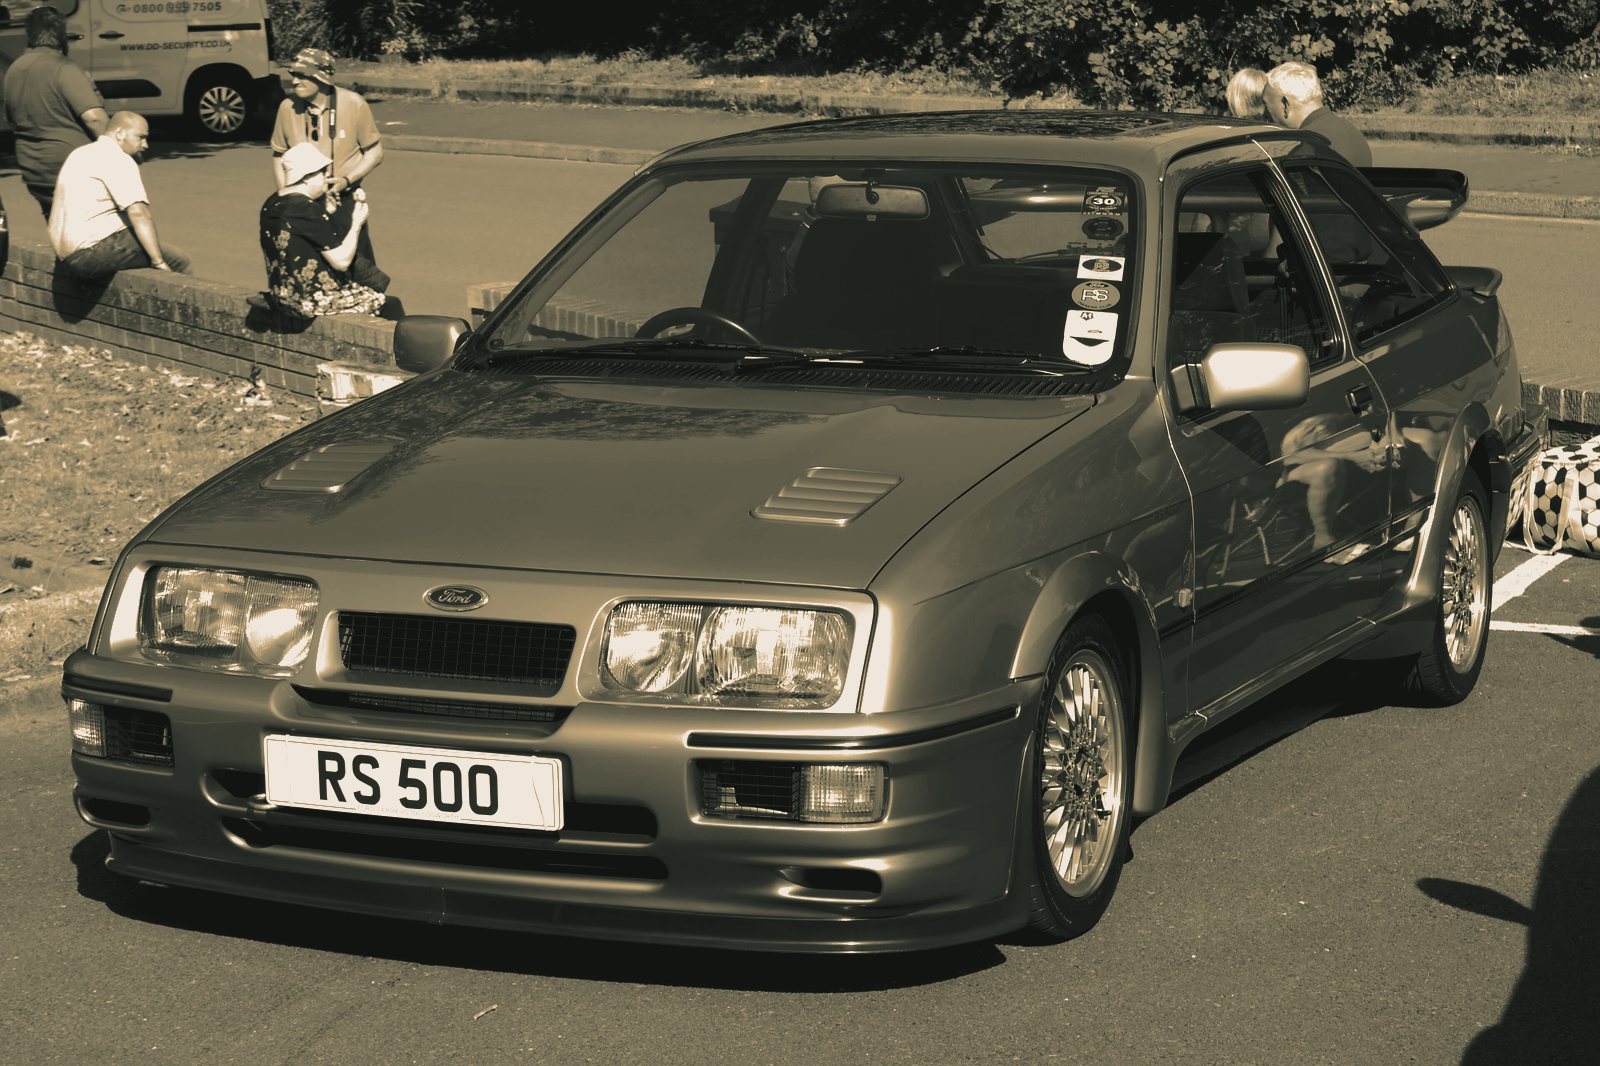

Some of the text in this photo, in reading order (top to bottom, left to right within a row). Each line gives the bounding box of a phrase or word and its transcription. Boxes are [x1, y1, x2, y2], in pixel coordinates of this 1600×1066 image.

[133, 3, 164, 13] 0800
[192, 2, 222, 11] 7505
[1092, 197, 1115, 205] 30
[438, 589, 473, 603] Ford
[317, 750, 498, 815] RS 500
